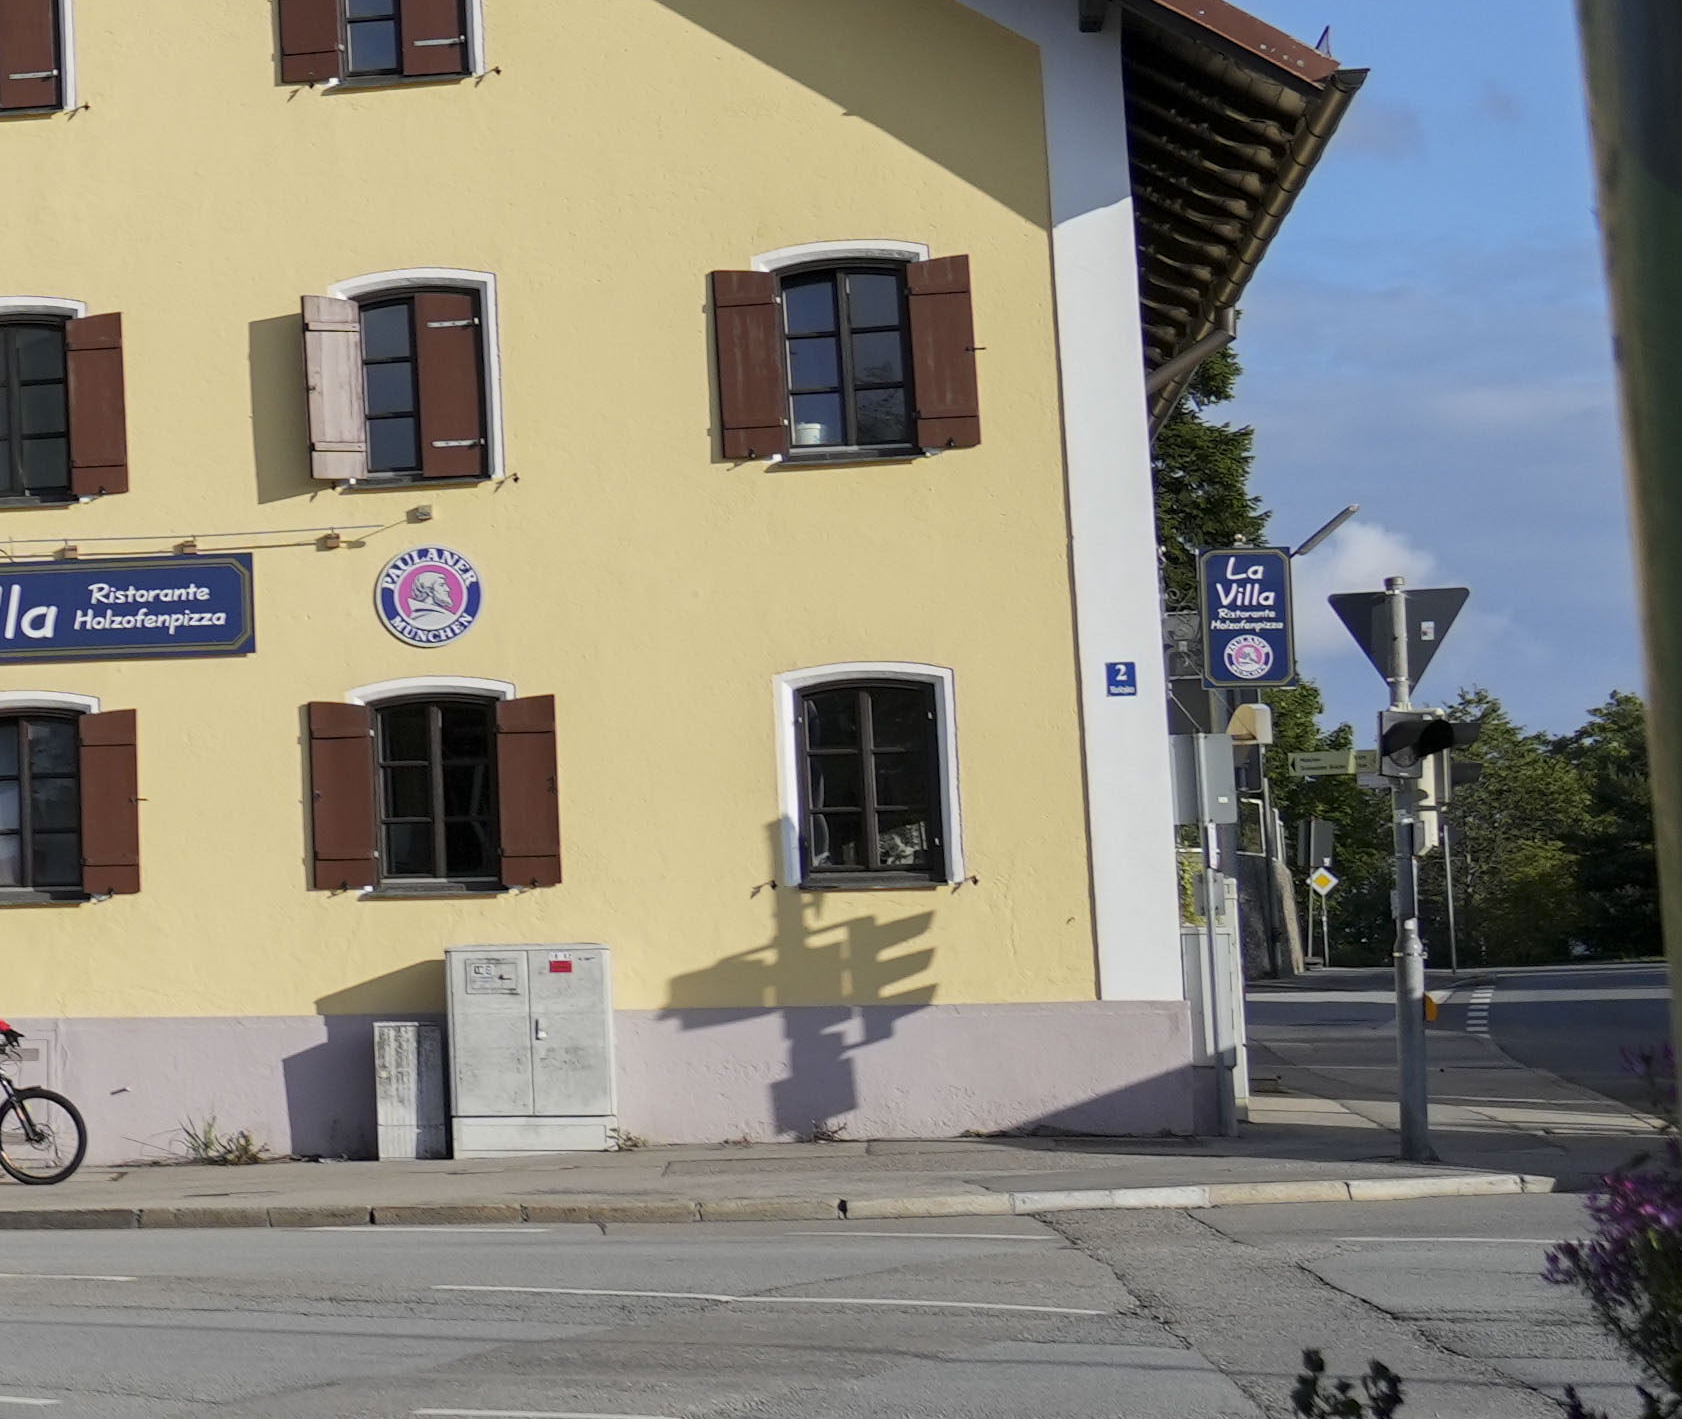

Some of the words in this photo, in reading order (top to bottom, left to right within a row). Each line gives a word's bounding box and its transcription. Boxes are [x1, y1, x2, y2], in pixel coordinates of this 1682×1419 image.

[382, 548, 478, 590] PAULANER
[1226, 556, 1265, 581] La
[87, 582, 211, 606] Ristorante
[1215, 582, 1276, 607] Villa
[73, 607, 227, 636] Holzofenpizza
[1217, 607, 1276, 619] Ristorante
[1210, 619, 1284, 633] Holzofenpizza
[1114, 664, 1128, 681] 2
